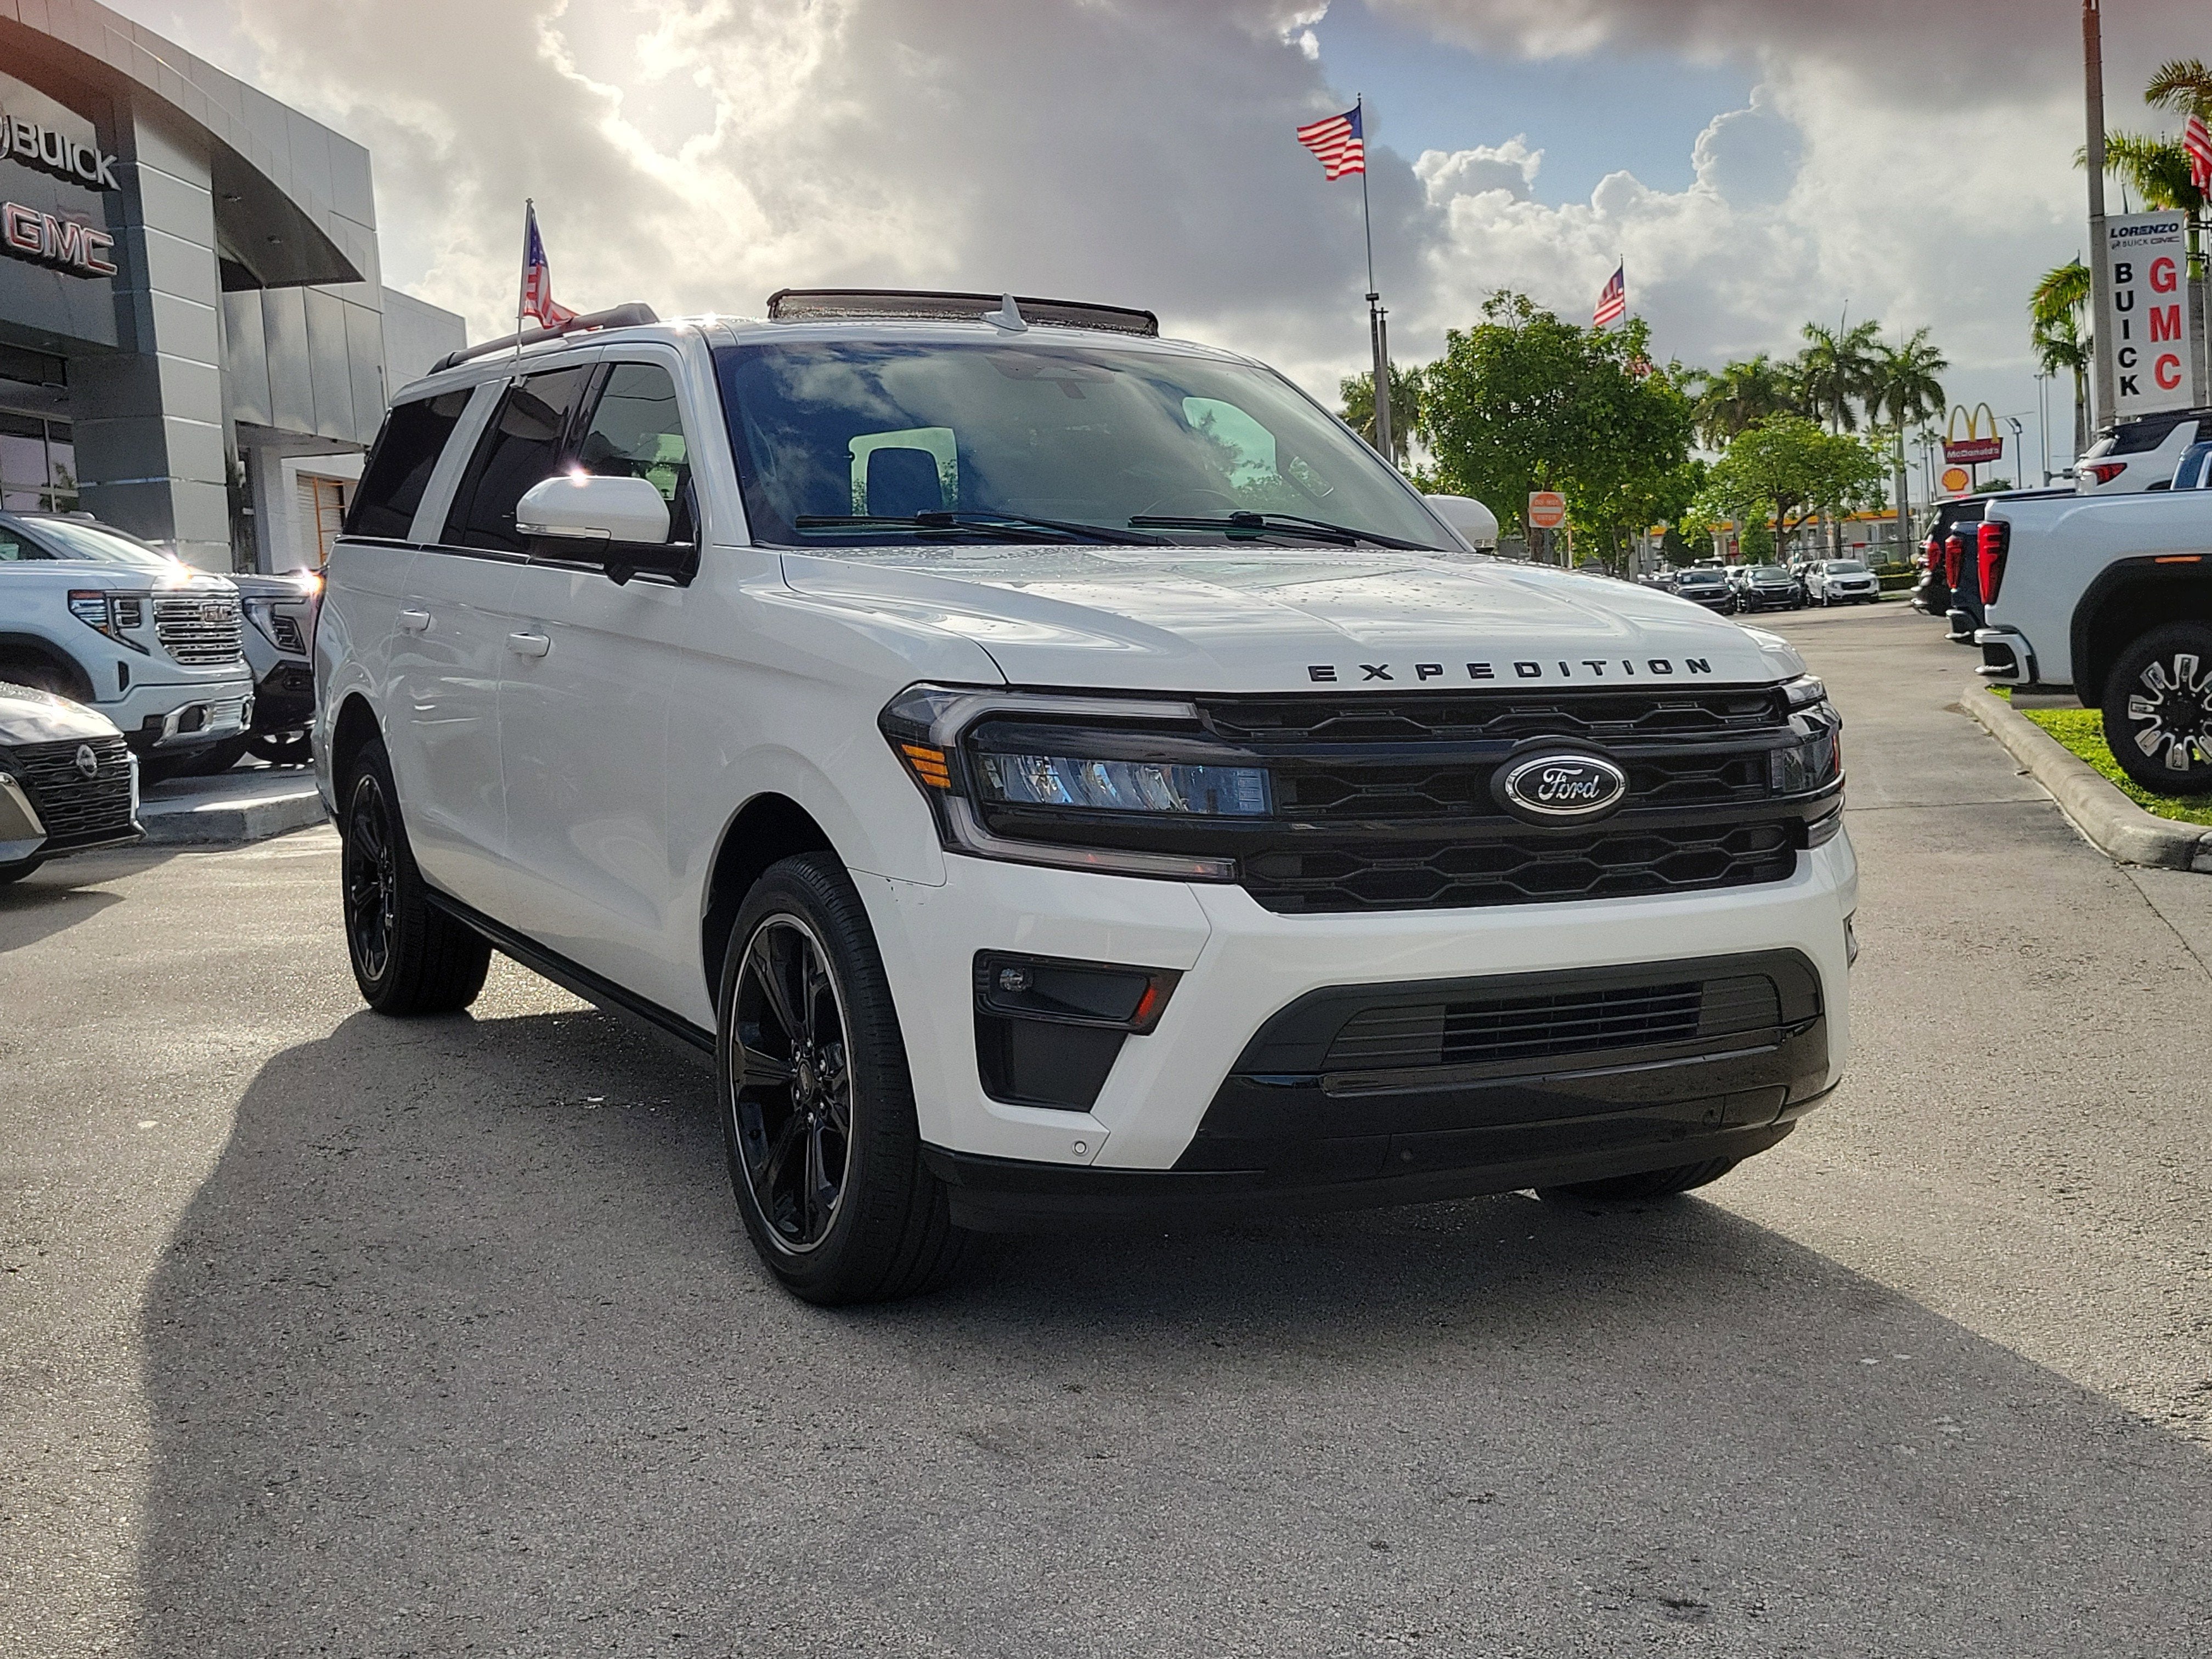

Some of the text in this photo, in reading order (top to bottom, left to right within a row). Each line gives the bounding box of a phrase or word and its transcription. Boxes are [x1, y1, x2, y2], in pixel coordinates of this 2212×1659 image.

[11, 116, 122, 191] BUICK
[5, 201, 118, 275] GMC
[2109, 223, 2179, 238] LORENZO
[2122, 238, 2148, 247] BUICK
[2114, 262, 2140, 397] BUICK
[2148, 256, 2182, 391] GMC
[1946, 447, 1999, 458] McDonald's
[1307, 658, 1712, 682] EXPEDITION
[1538, 768, 1600, 800] Ford
